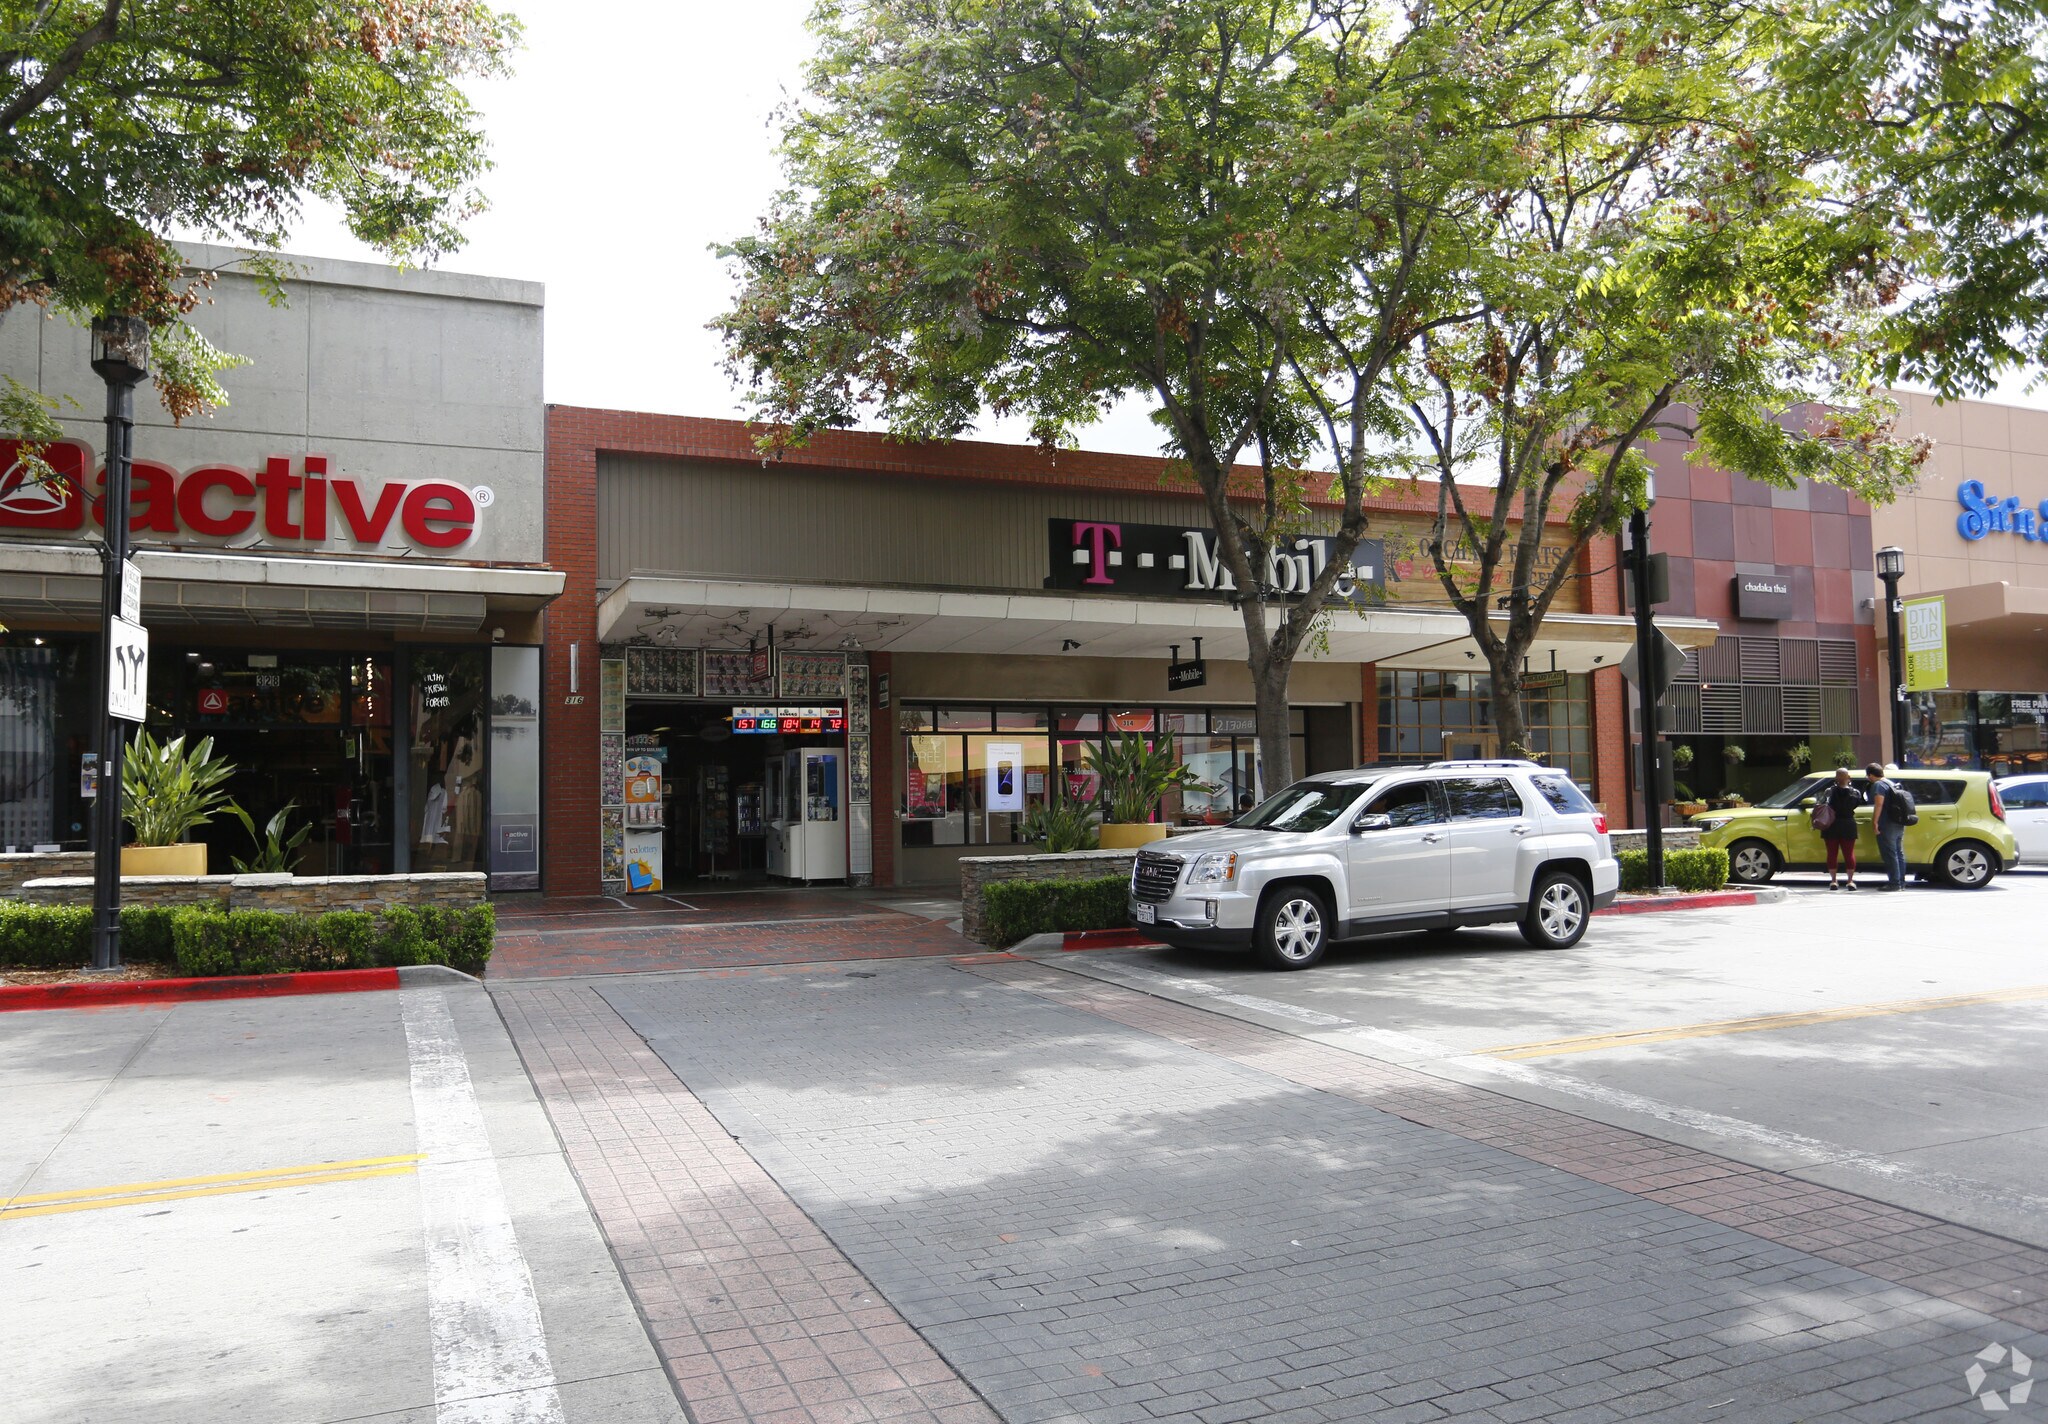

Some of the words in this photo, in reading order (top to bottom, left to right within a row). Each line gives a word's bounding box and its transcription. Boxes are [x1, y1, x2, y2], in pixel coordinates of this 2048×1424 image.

[92, 456, 475, 548] active
[1181, 531, 1356, 598] Mbile
[1744, 582, 1773, 593] chadaka
[1773, 584, 1787, 594] thai
[1909, 606, 1938, 625] DTN
[1910, 623, 1938, 641] BUR
[256, 675, 280, 687] 328
[1180, 668, 1200, 682] Mobile
[565, 696, 583, 704] 316
[2011, 699, 2031, 708] FREE
[738, 719, 755, 729] 157
[761, 719, 777, 729] 166
[783, 719, 799, 729] 184
[810, 719, 821, 729] 14
[830, 719, 842, 729] 72
[912, 751, 941, 764] FREE
